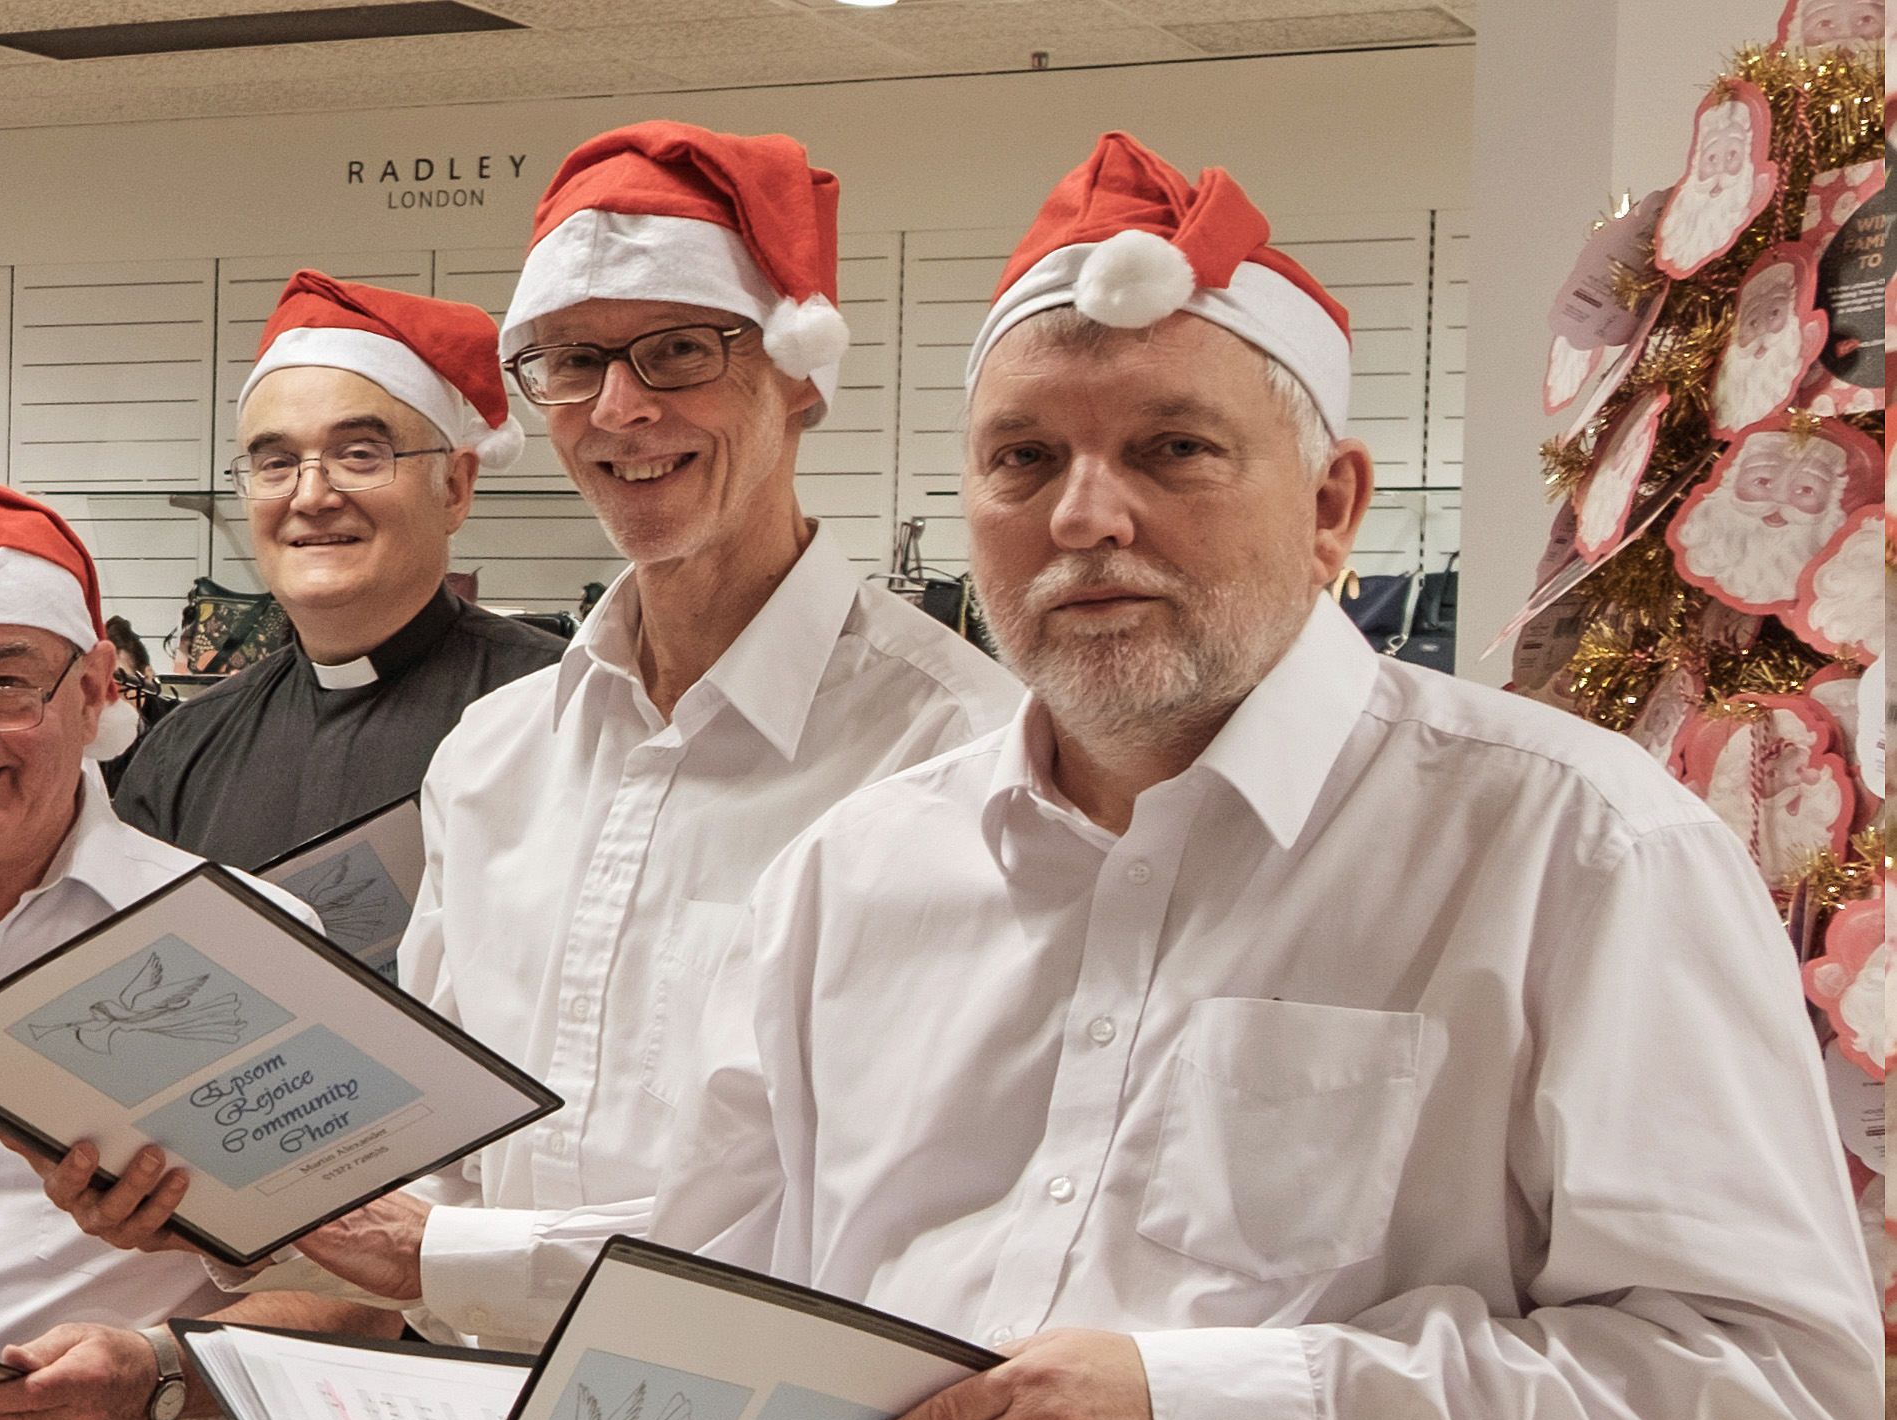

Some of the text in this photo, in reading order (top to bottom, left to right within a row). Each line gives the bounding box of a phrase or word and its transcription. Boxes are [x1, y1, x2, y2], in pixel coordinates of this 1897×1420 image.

[348, 154, 527, 184] RADLEY
[388, 188, 485, 210] LONDON
[1858, 253, 1883, 270] TO
[190, 1054, 288, 1108] Epsom
[215, 1069, 314, 1126] Rejoice
[222, 1078, 360, 1153] Community
[279, 1111, 352, 1153] Choir
